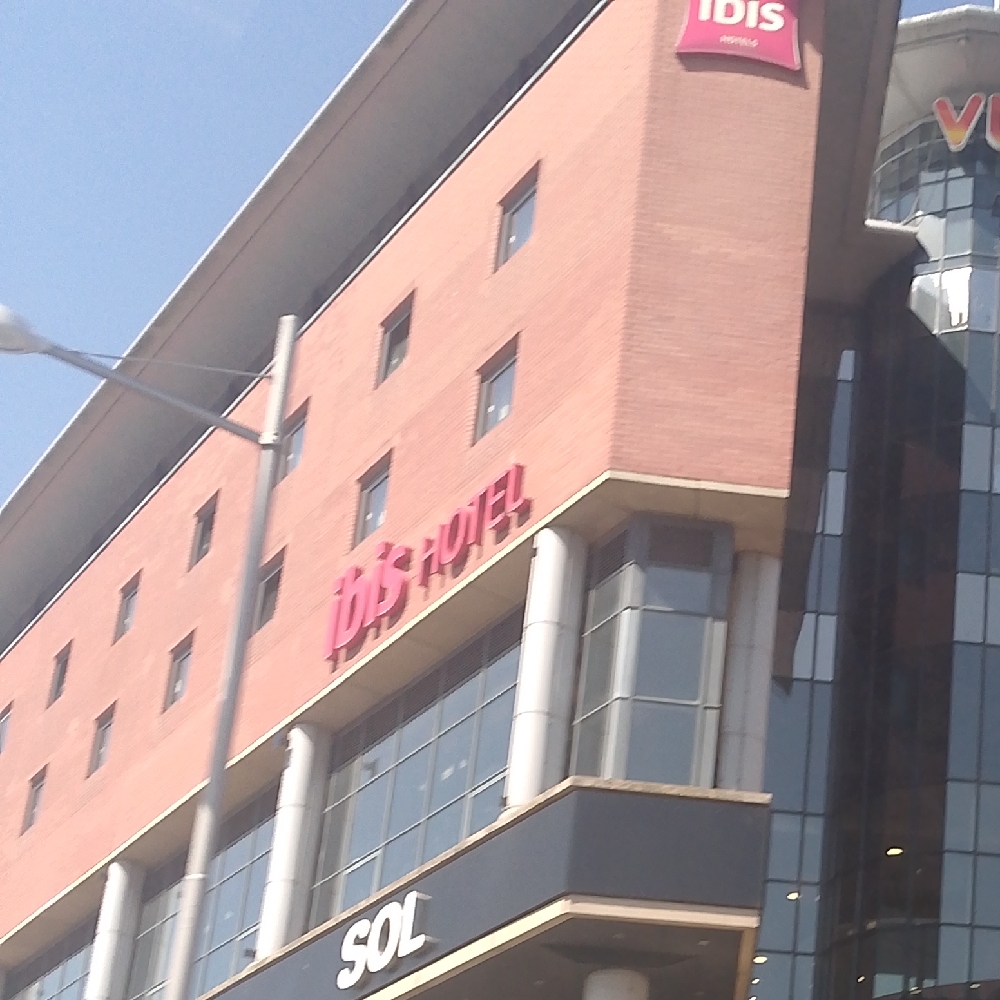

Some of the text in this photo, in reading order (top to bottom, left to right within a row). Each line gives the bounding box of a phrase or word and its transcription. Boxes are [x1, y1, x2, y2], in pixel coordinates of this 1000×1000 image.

[324, 463, 533, 661] ibis HOTEL
[336, 890, 426, 990] SOL
